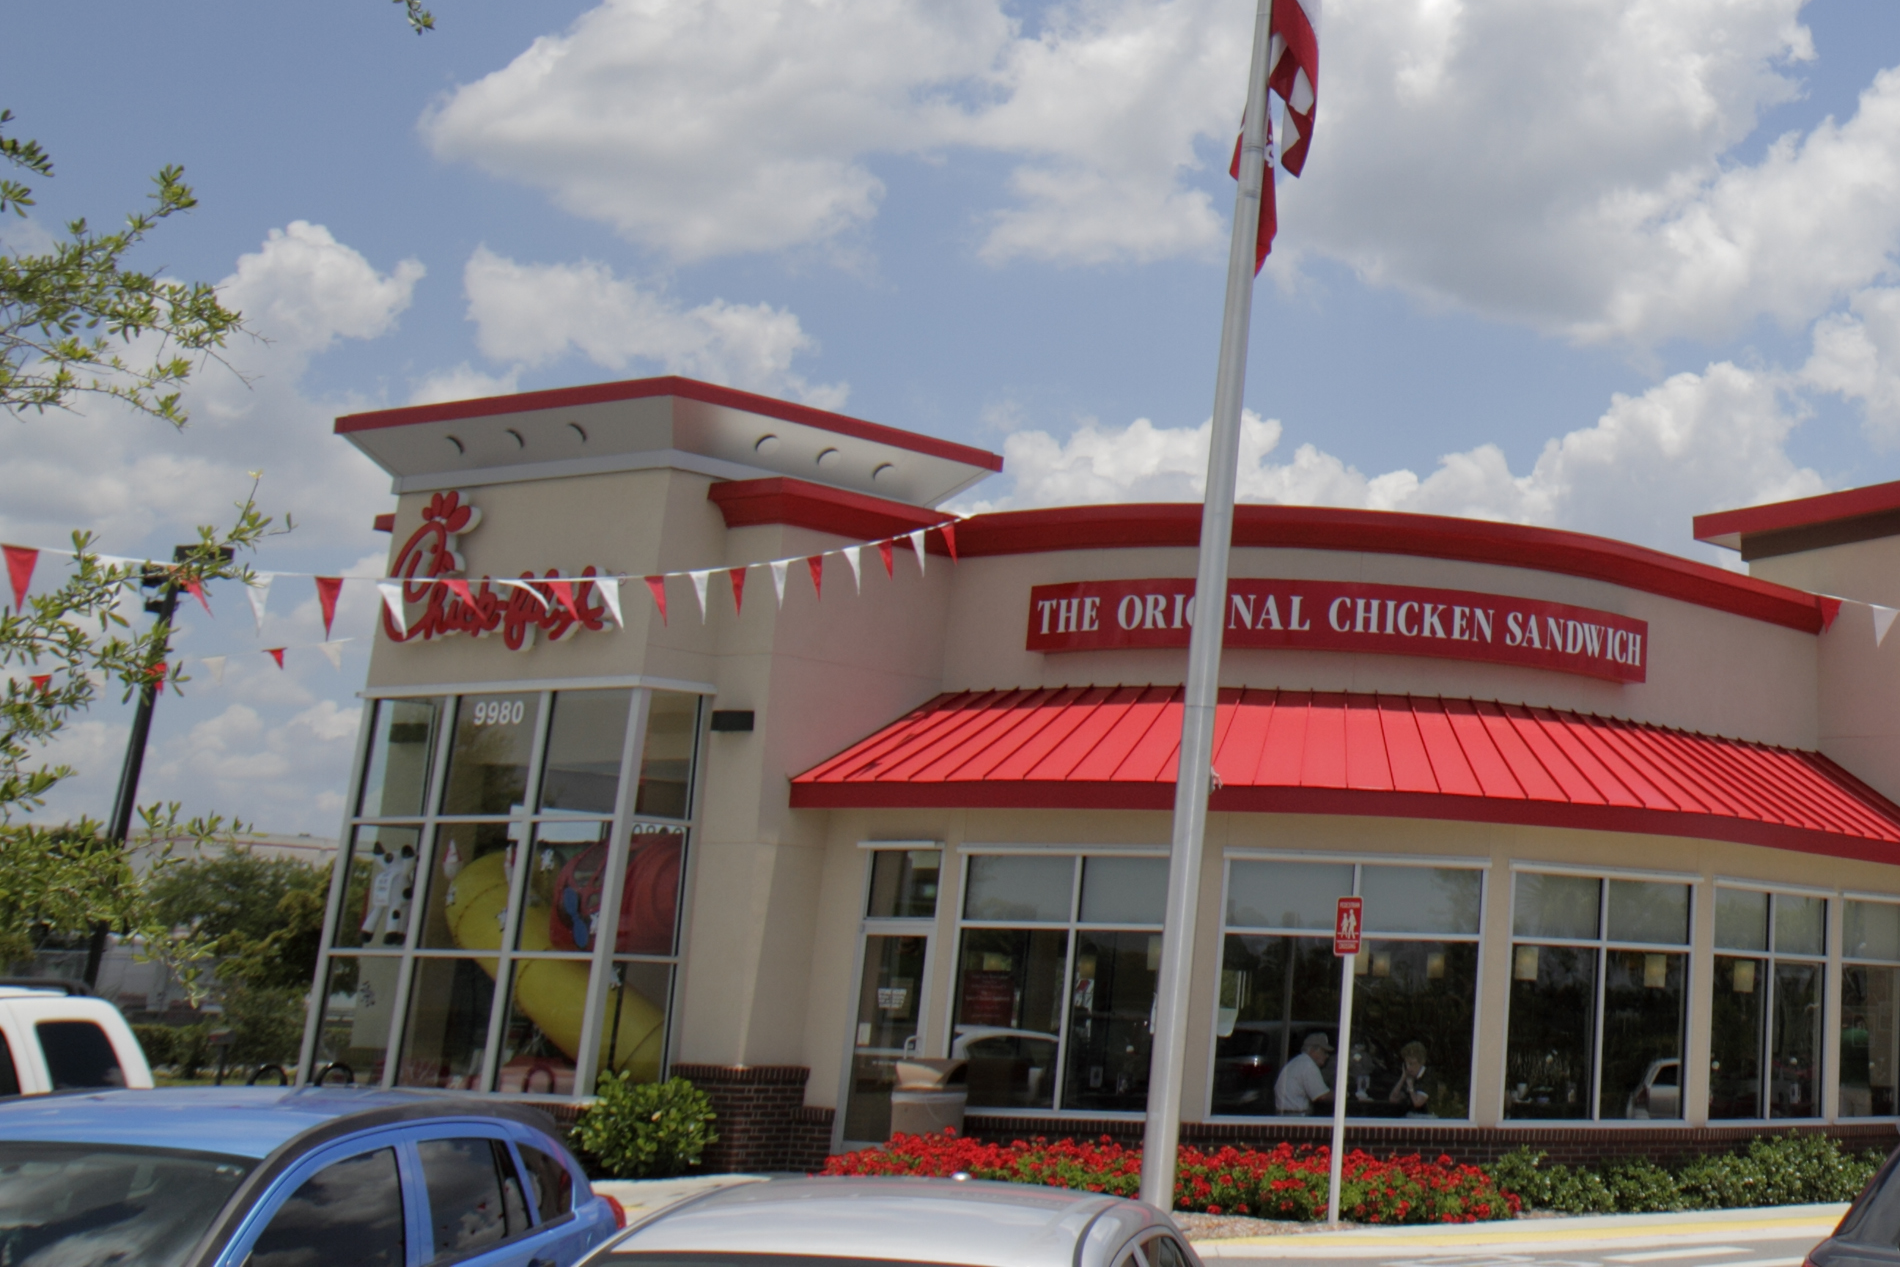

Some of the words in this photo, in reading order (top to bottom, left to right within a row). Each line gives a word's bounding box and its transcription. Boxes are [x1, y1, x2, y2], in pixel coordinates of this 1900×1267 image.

[1037, 596, 1102, 635] THE
[1116, 593, 1311, 632] ORINAL
[1327, 595, 1496, 646] CHICKEN
[1504, 610, 1643, 668] SANDWICH
[473, 699, 525, 726] 9980
